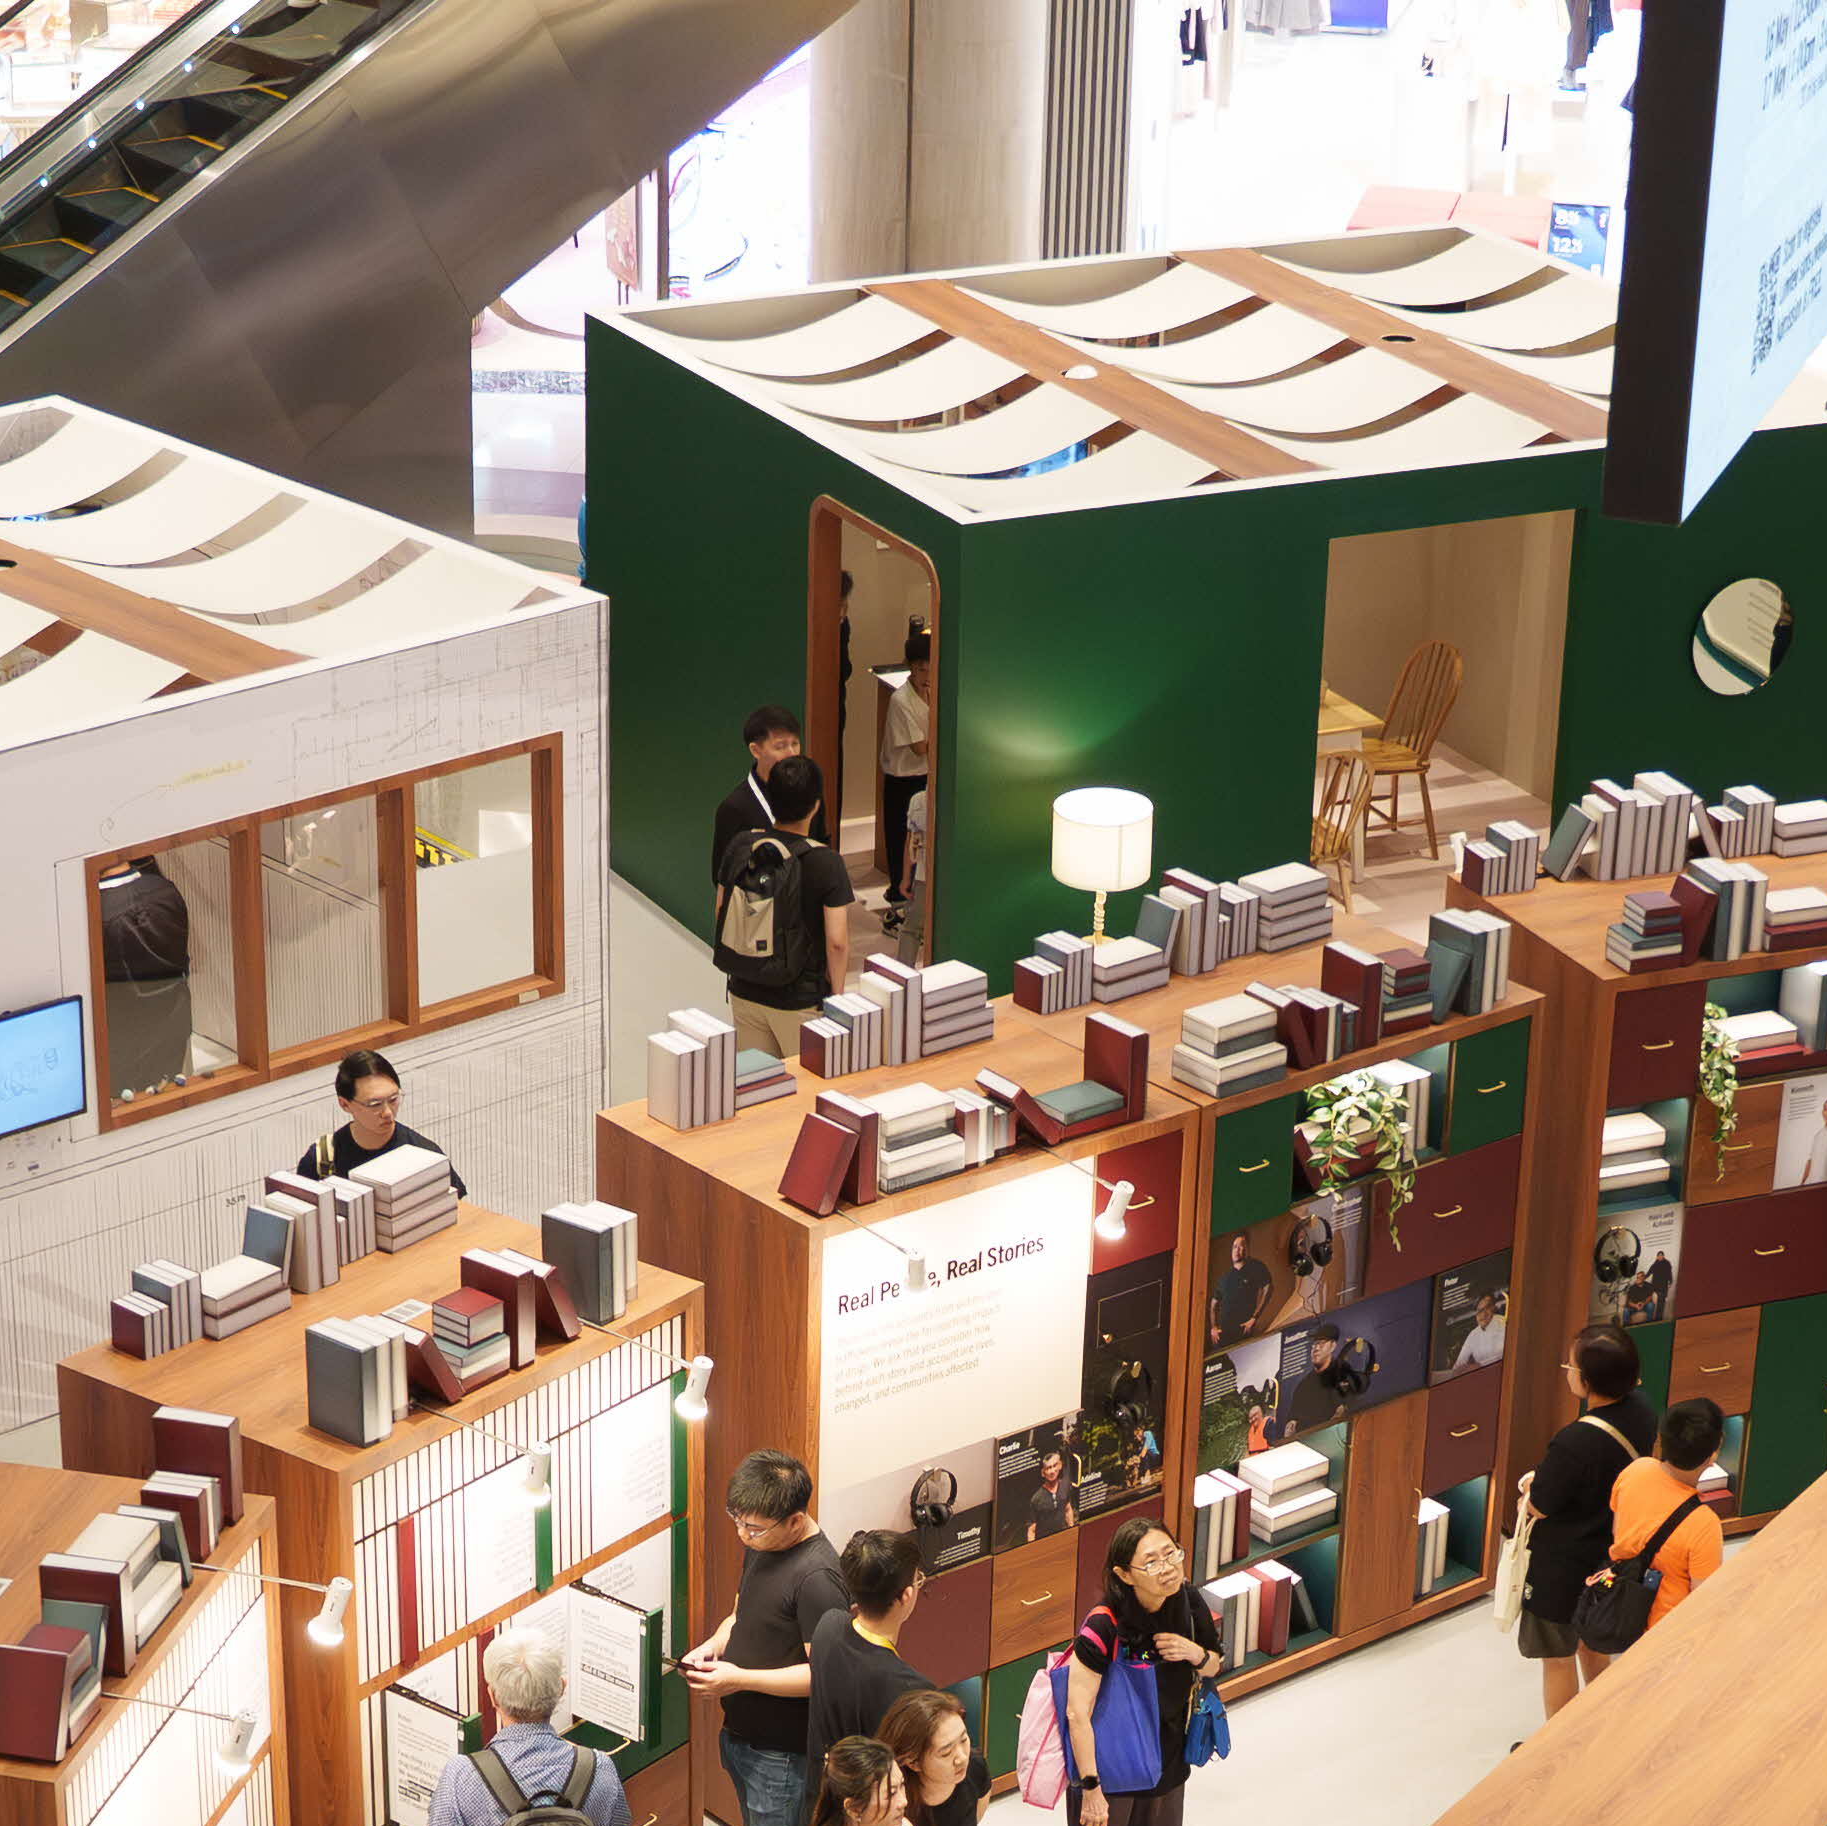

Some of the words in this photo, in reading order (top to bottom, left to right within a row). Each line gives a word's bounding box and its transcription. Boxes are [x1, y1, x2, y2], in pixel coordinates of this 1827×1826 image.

[839, 1286, 873, 1315] Real
[880, 1263, 941, 1305] Pee,
[948, 1252, 982, 1280] Real
[988, 1238, 1043, 1267] Stories
[999, 1441, 1020, 1455] Charlie
[957, 1525, 981, 1540] Timothy
